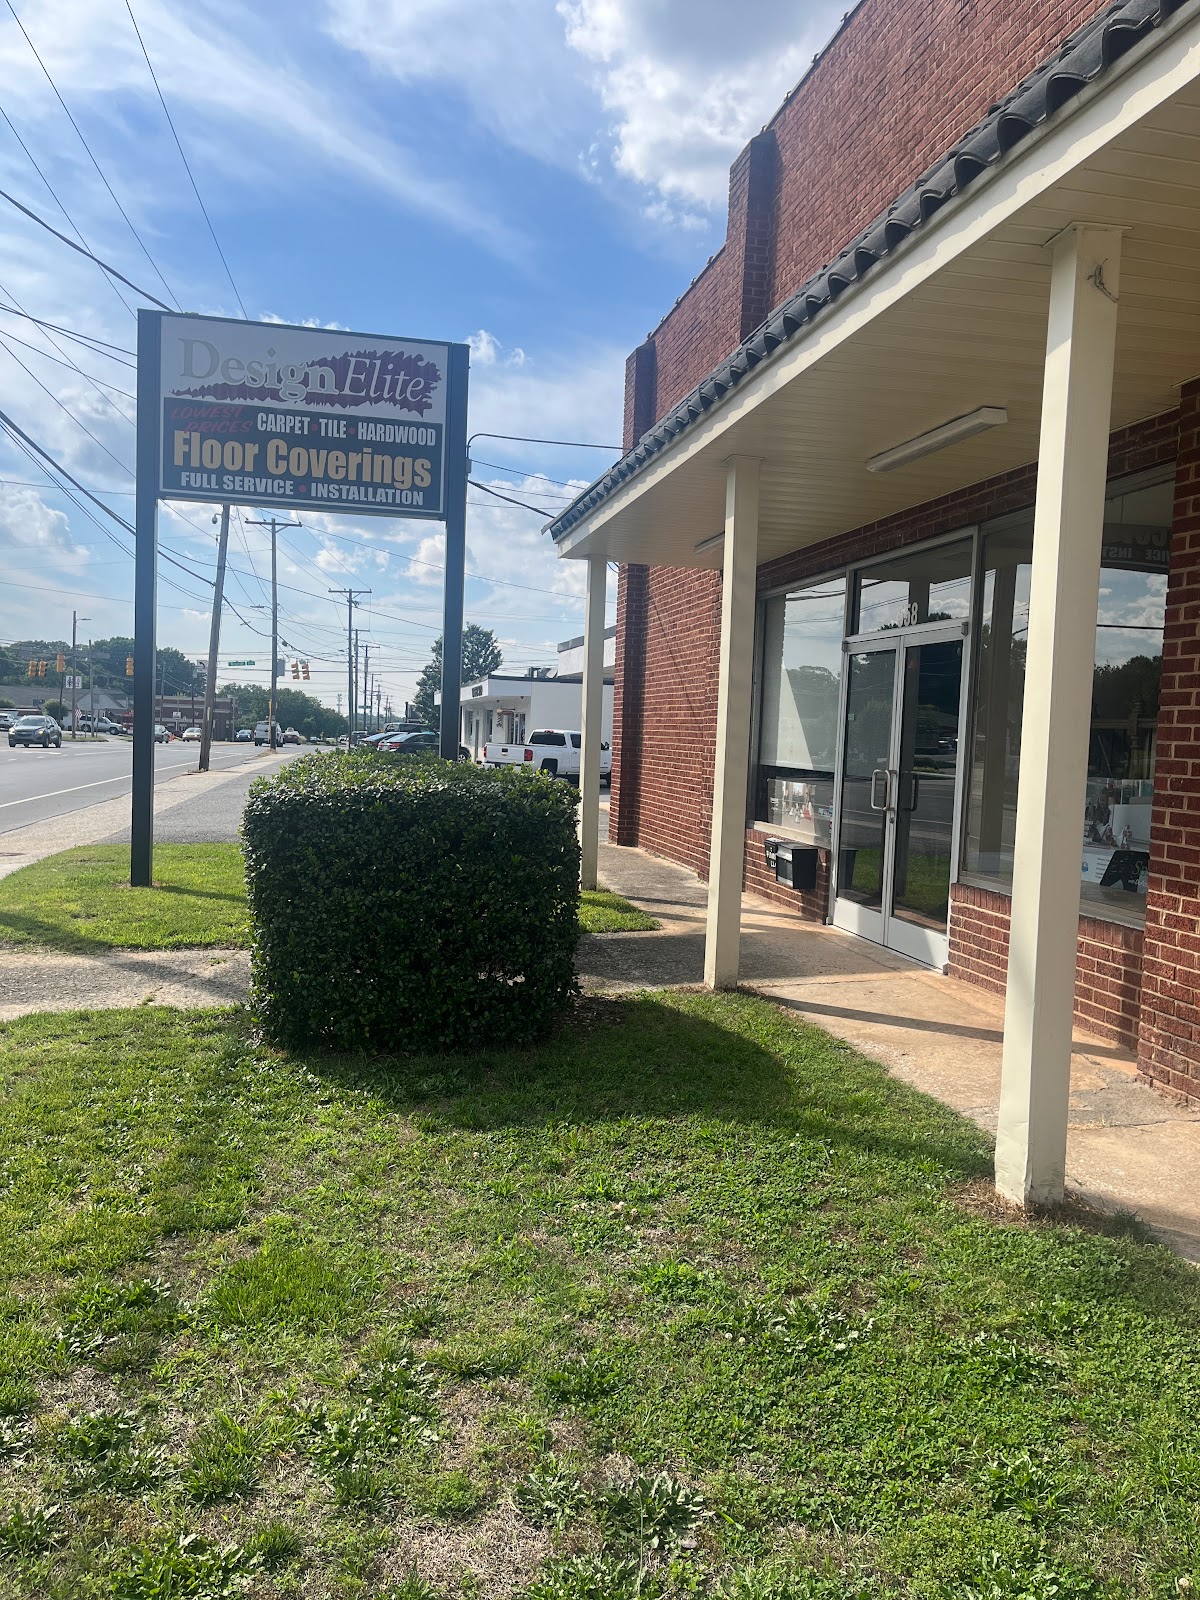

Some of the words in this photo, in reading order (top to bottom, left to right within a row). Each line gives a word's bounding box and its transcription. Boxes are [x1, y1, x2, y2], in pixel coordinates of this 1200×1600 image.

[257, 412, 311, 435] CARPET
[319, 419, 347, 439] TILE
[357, 422, 436, 446] HARDWOOD
[173, 429, 259, 473] Floor
[266, 438, 432, 490] Coverings
[181, 471, 219, 490] FULL
[222, 475, 294, 495] SERVICE
[310, 482, 424, 506] INSTALLATION
